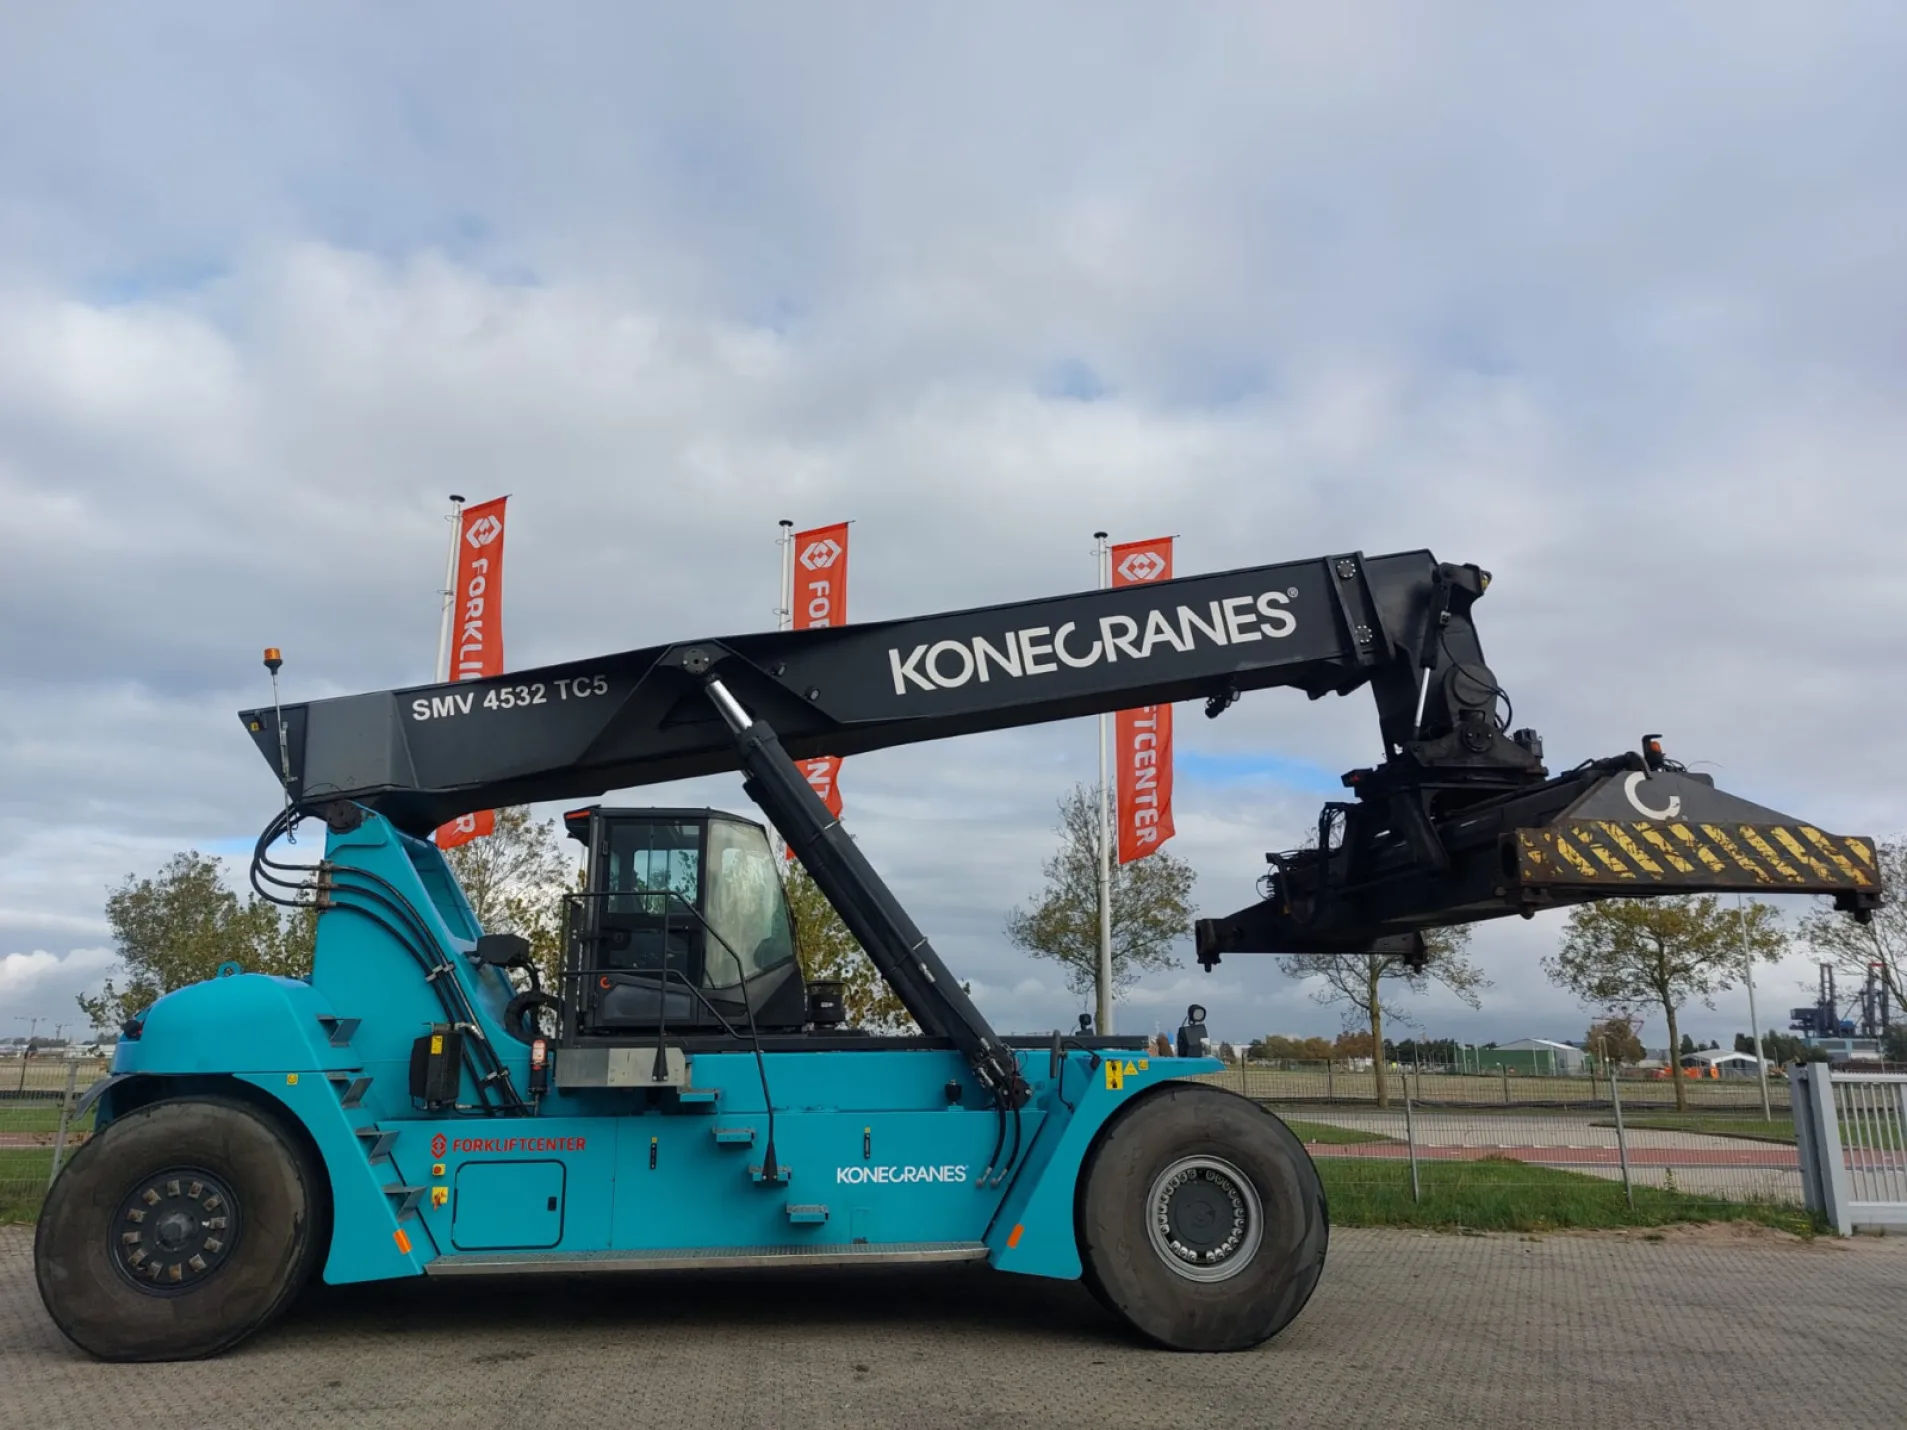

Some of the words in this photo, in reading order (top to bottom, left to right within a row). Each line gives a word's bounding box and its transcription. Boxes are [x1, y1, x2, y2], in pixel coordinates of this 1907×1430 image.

[412, 692, 474, 721] SMV
[483, 683, 548, 710] 4532
[554, 674, 610, 700] TC5
[452, 1137, 586, 1153] FORKLIFTCENTER
